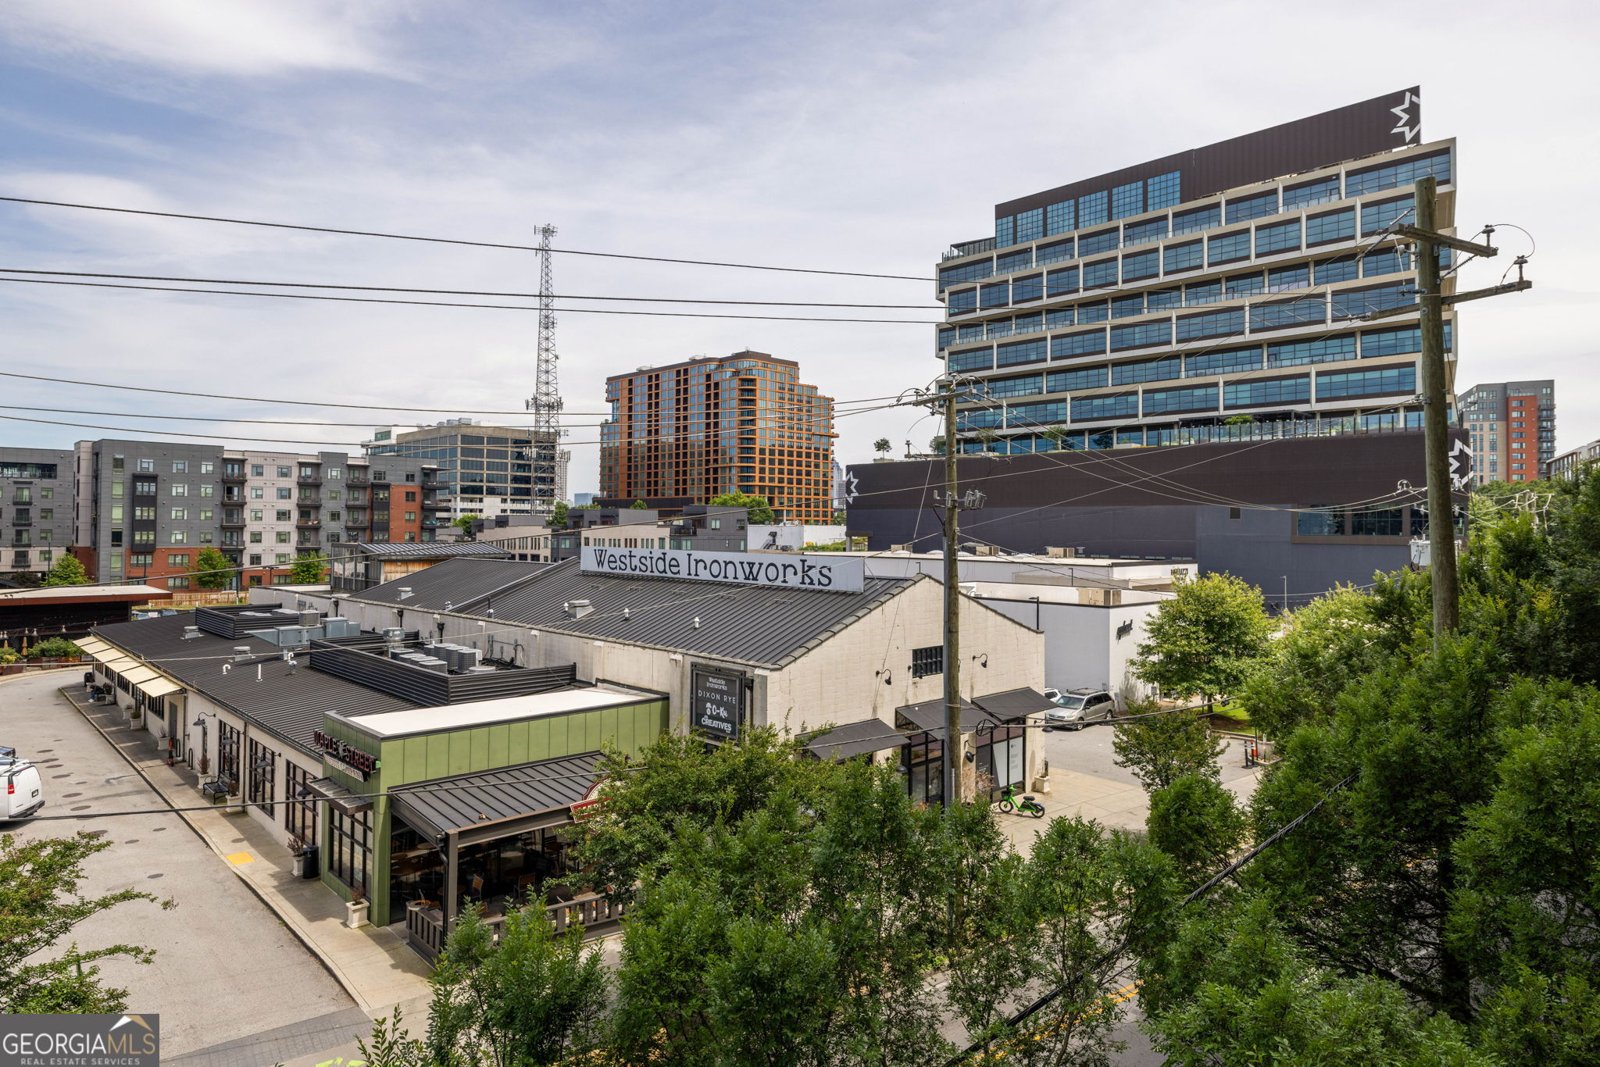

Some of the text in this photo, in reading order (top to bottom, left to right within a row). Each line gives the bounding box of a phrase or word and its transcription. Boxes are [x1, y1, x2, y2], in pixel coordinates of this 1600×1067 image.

[594, 549, 832, 587] Westside Ironworks
[698, 690, 736, 704] DIXON RYE
[701, 717, 731, 730] CREATIVES
[313, 729, 338, 754] MAPLE
[345, 745, 376, 774] STREET
